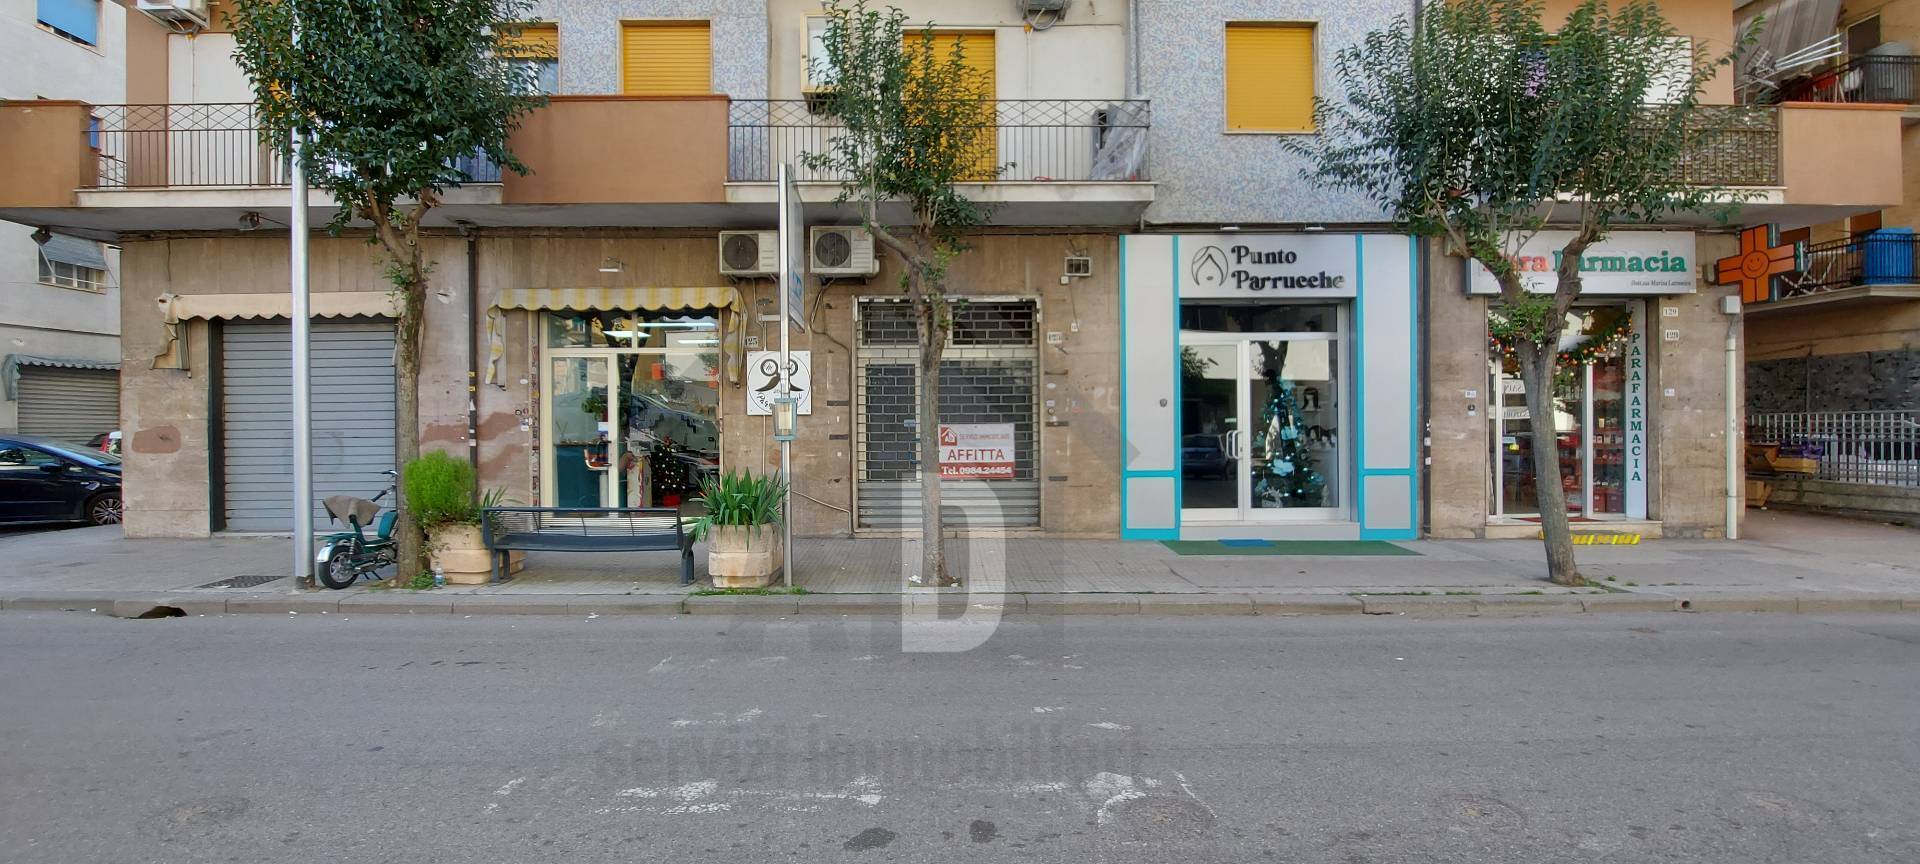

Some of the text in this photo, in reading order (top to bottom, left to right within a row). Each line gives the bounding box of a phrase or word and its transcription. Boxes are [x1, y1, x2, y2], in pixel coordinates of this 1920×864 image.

[1231, 245, 1297, 265] Punto
[1231, 270, 1345, 291] Parrucche
[1630, 333, 1642, 482] PARAFARMACIA
[947, 448, 1005, 461] AFFITTA
[941, 466, 958, 475] Tel.
